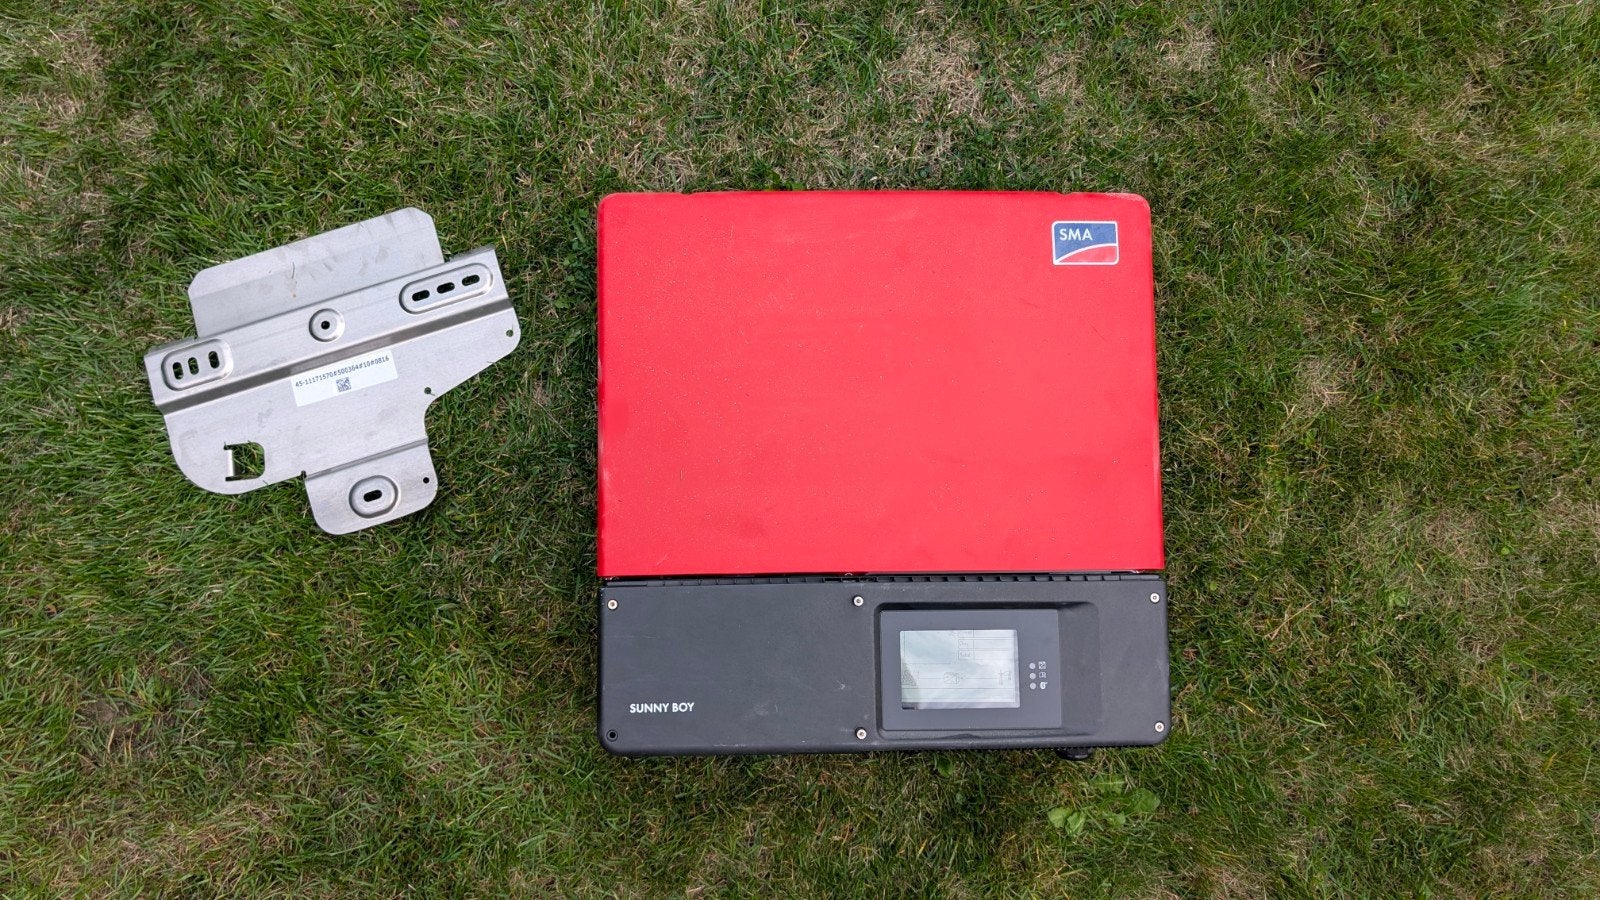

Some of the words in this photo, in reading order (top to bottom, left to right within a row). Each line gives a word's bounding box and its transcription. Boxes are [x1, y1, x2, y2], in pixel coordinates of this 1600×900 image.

[1059, 228, 1093, 241] SMA
[629, 703, 669, 713] SUNNY
[672, 702, 695, 712] BOY
